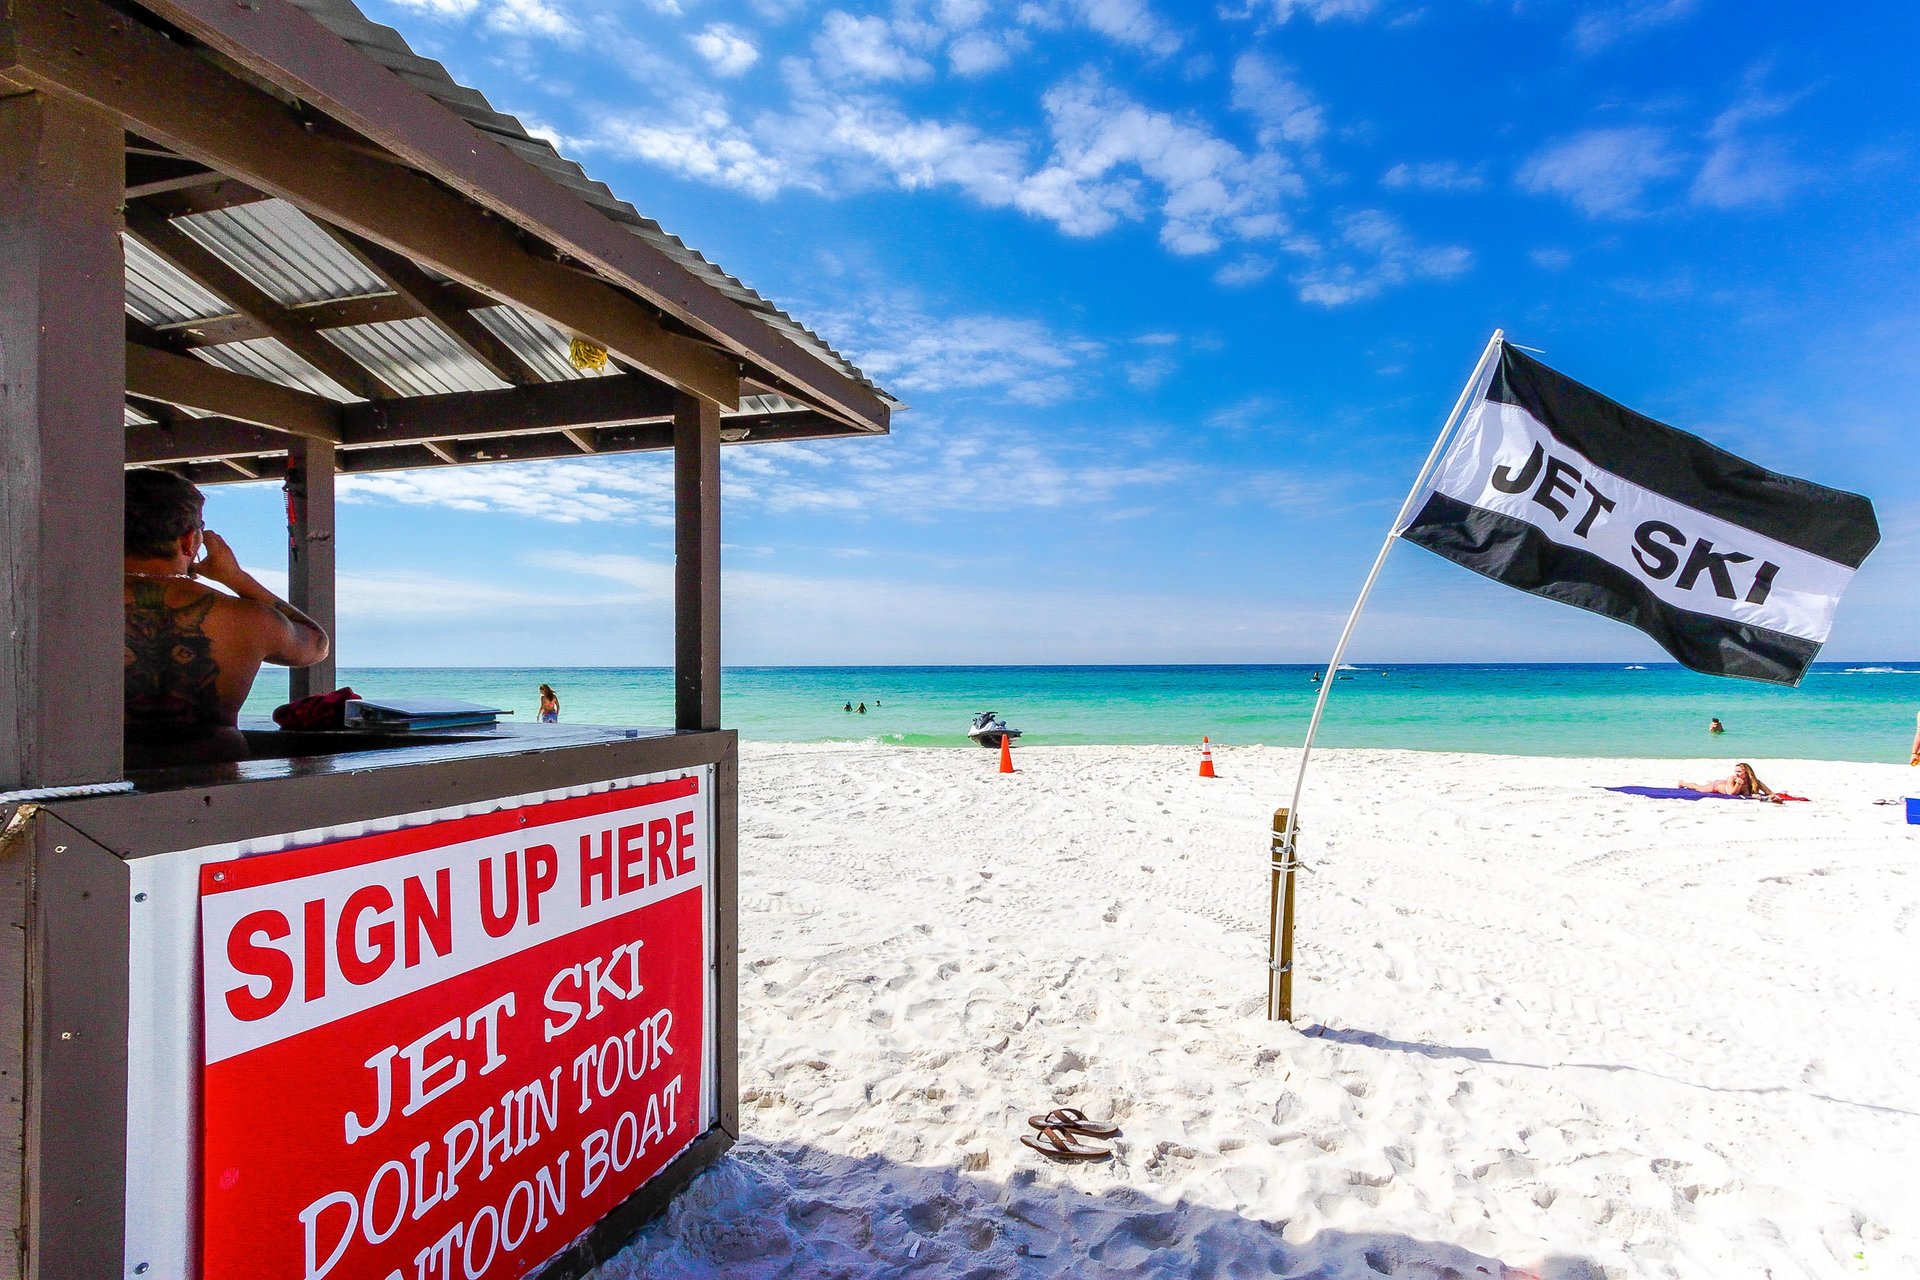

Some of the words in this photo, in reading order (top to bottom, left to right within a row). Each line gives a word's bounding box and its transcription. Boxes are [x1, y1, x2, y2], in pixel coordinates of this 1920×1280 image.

[1491, 441, 1616, 539] JET
[1631, 521, 1780, 605] SKI
[225, 867, 453, 1022] SIGN
[479, 844, 558, 938] UP
[579, 810, 696, 908] HERE
[298, 1066, 562, 1280] DOLPHIN
[573, 1008, 673, 1113] TOUR
[345, 992, 516, 1144] JET
[543, 939, 645, 1042] SKI
[581, 1075, 682, 1199] BOAT
